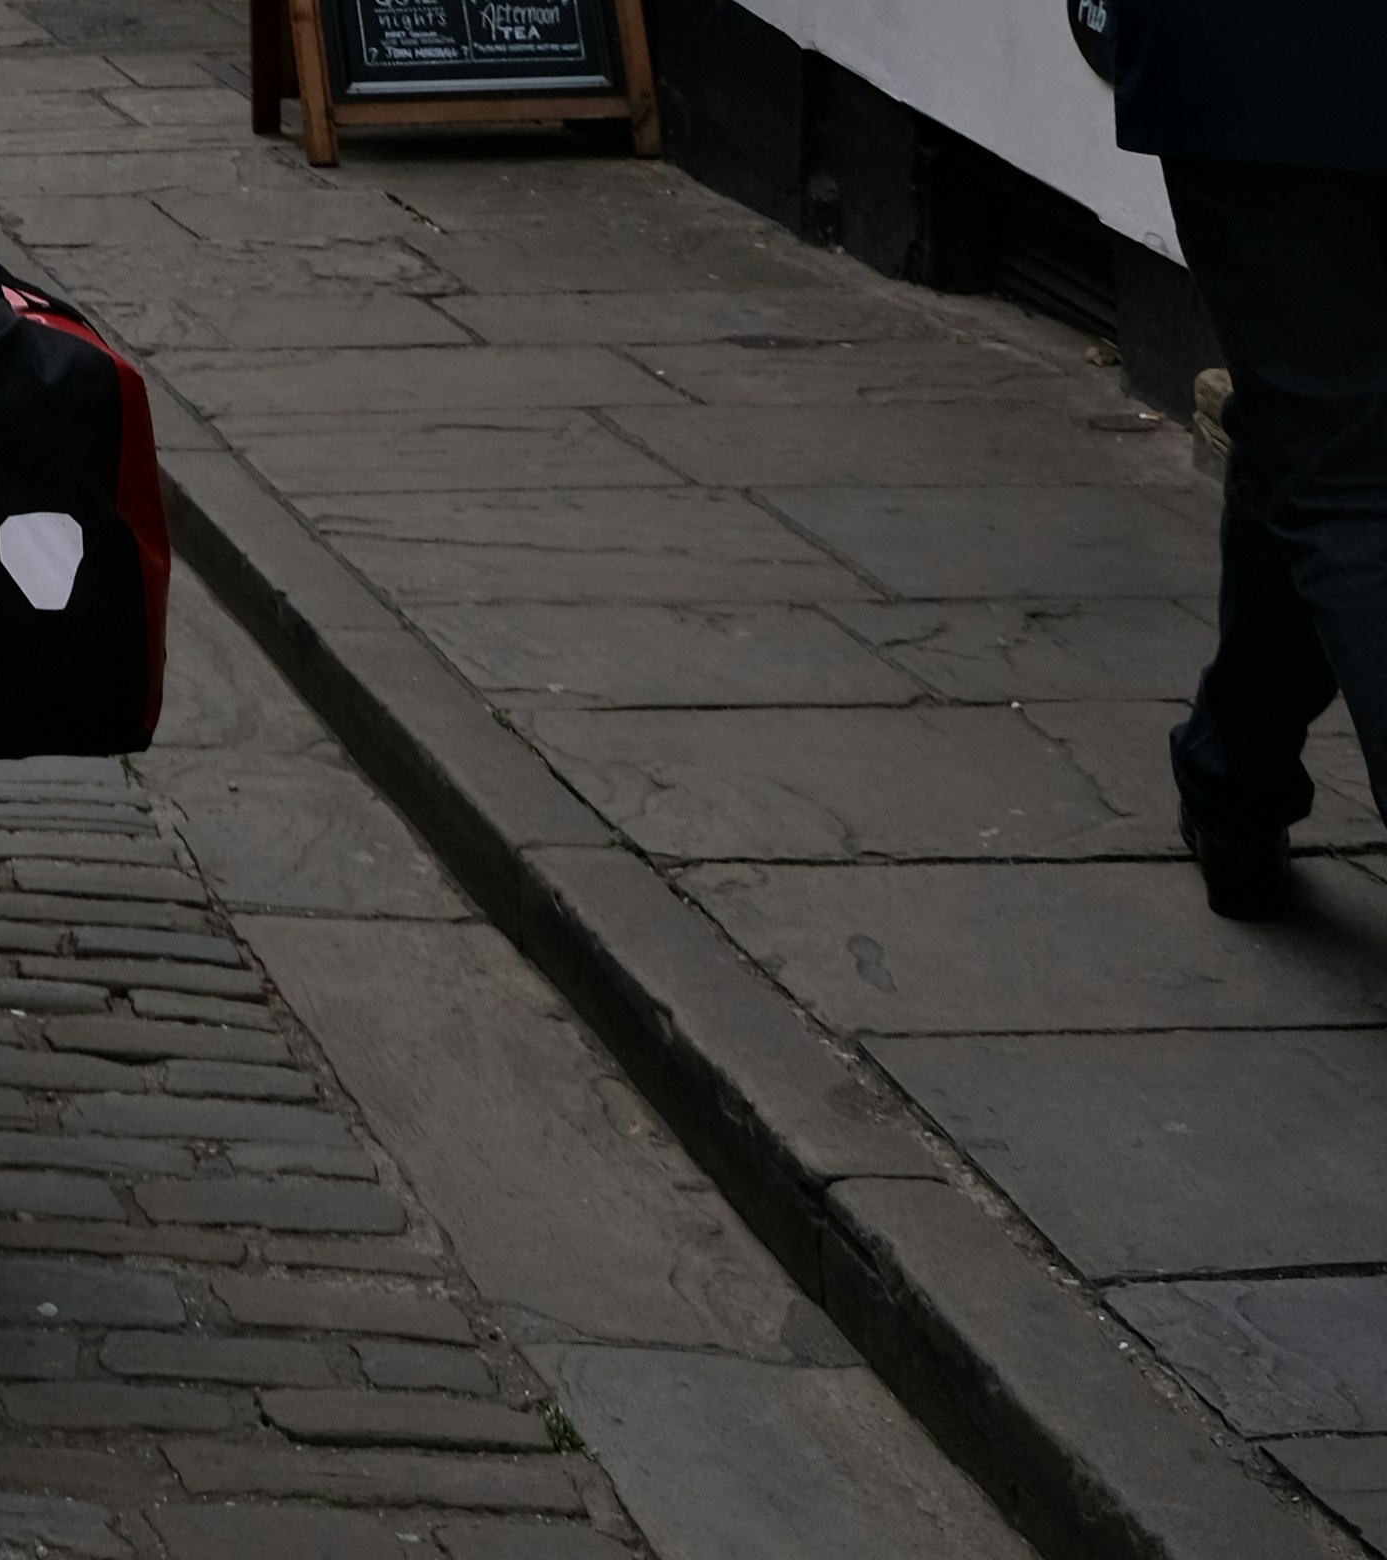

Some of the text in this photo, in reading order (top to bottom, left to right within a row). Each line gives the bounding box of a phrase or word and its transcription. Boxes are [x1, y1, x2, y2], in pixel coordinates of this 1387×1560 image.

[377, 10, 449, 32] nights
[479, 2, 560, 41] Afternoon
[497, 25, 542, 41] TEA
